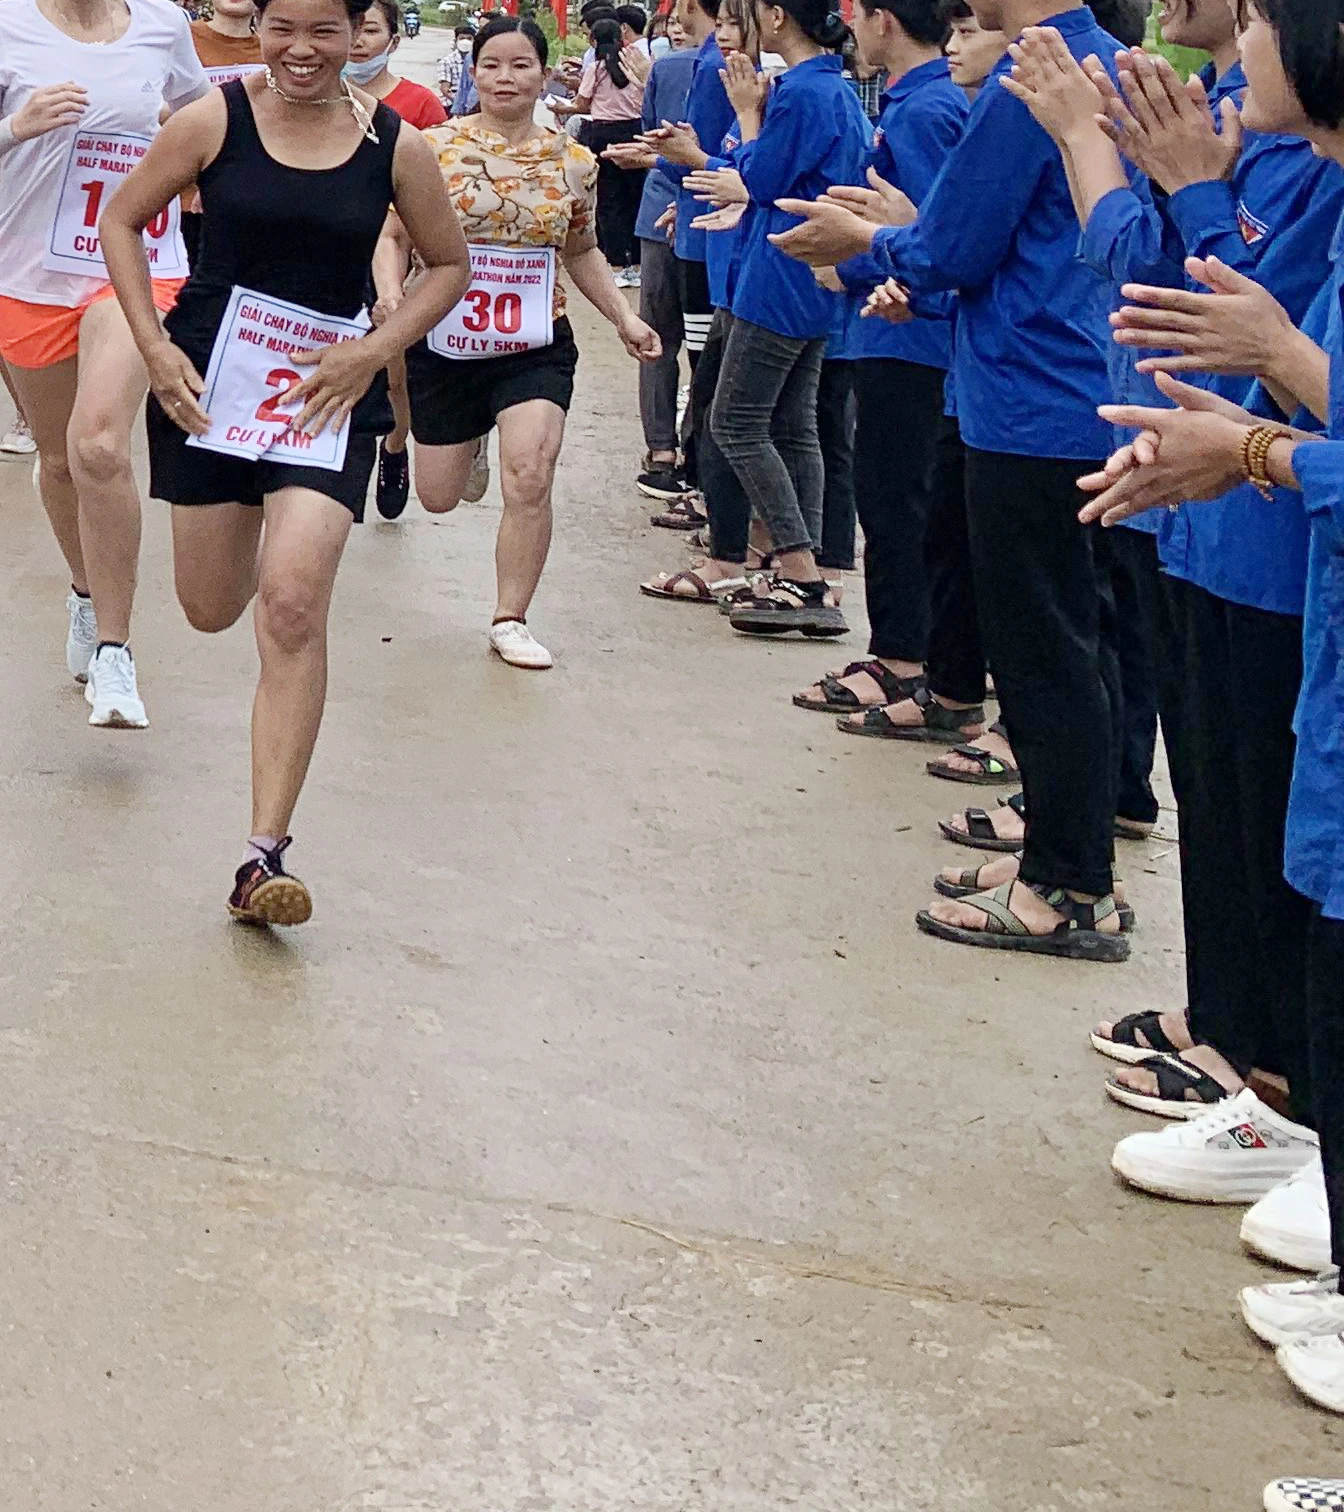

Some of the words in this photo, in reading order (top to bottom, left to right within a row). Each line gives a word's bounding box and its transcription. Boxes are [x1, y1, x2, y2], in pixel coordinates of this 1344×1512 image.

[77, 156, 98, 169] HALF
[526, 258, 546, 269] XANH
[463, 290, 522, 334] 30
[238, 328, 265, 346] HALF
[471, 339, 489, 351] LY
[494, 340, 529, 352] 5KM
